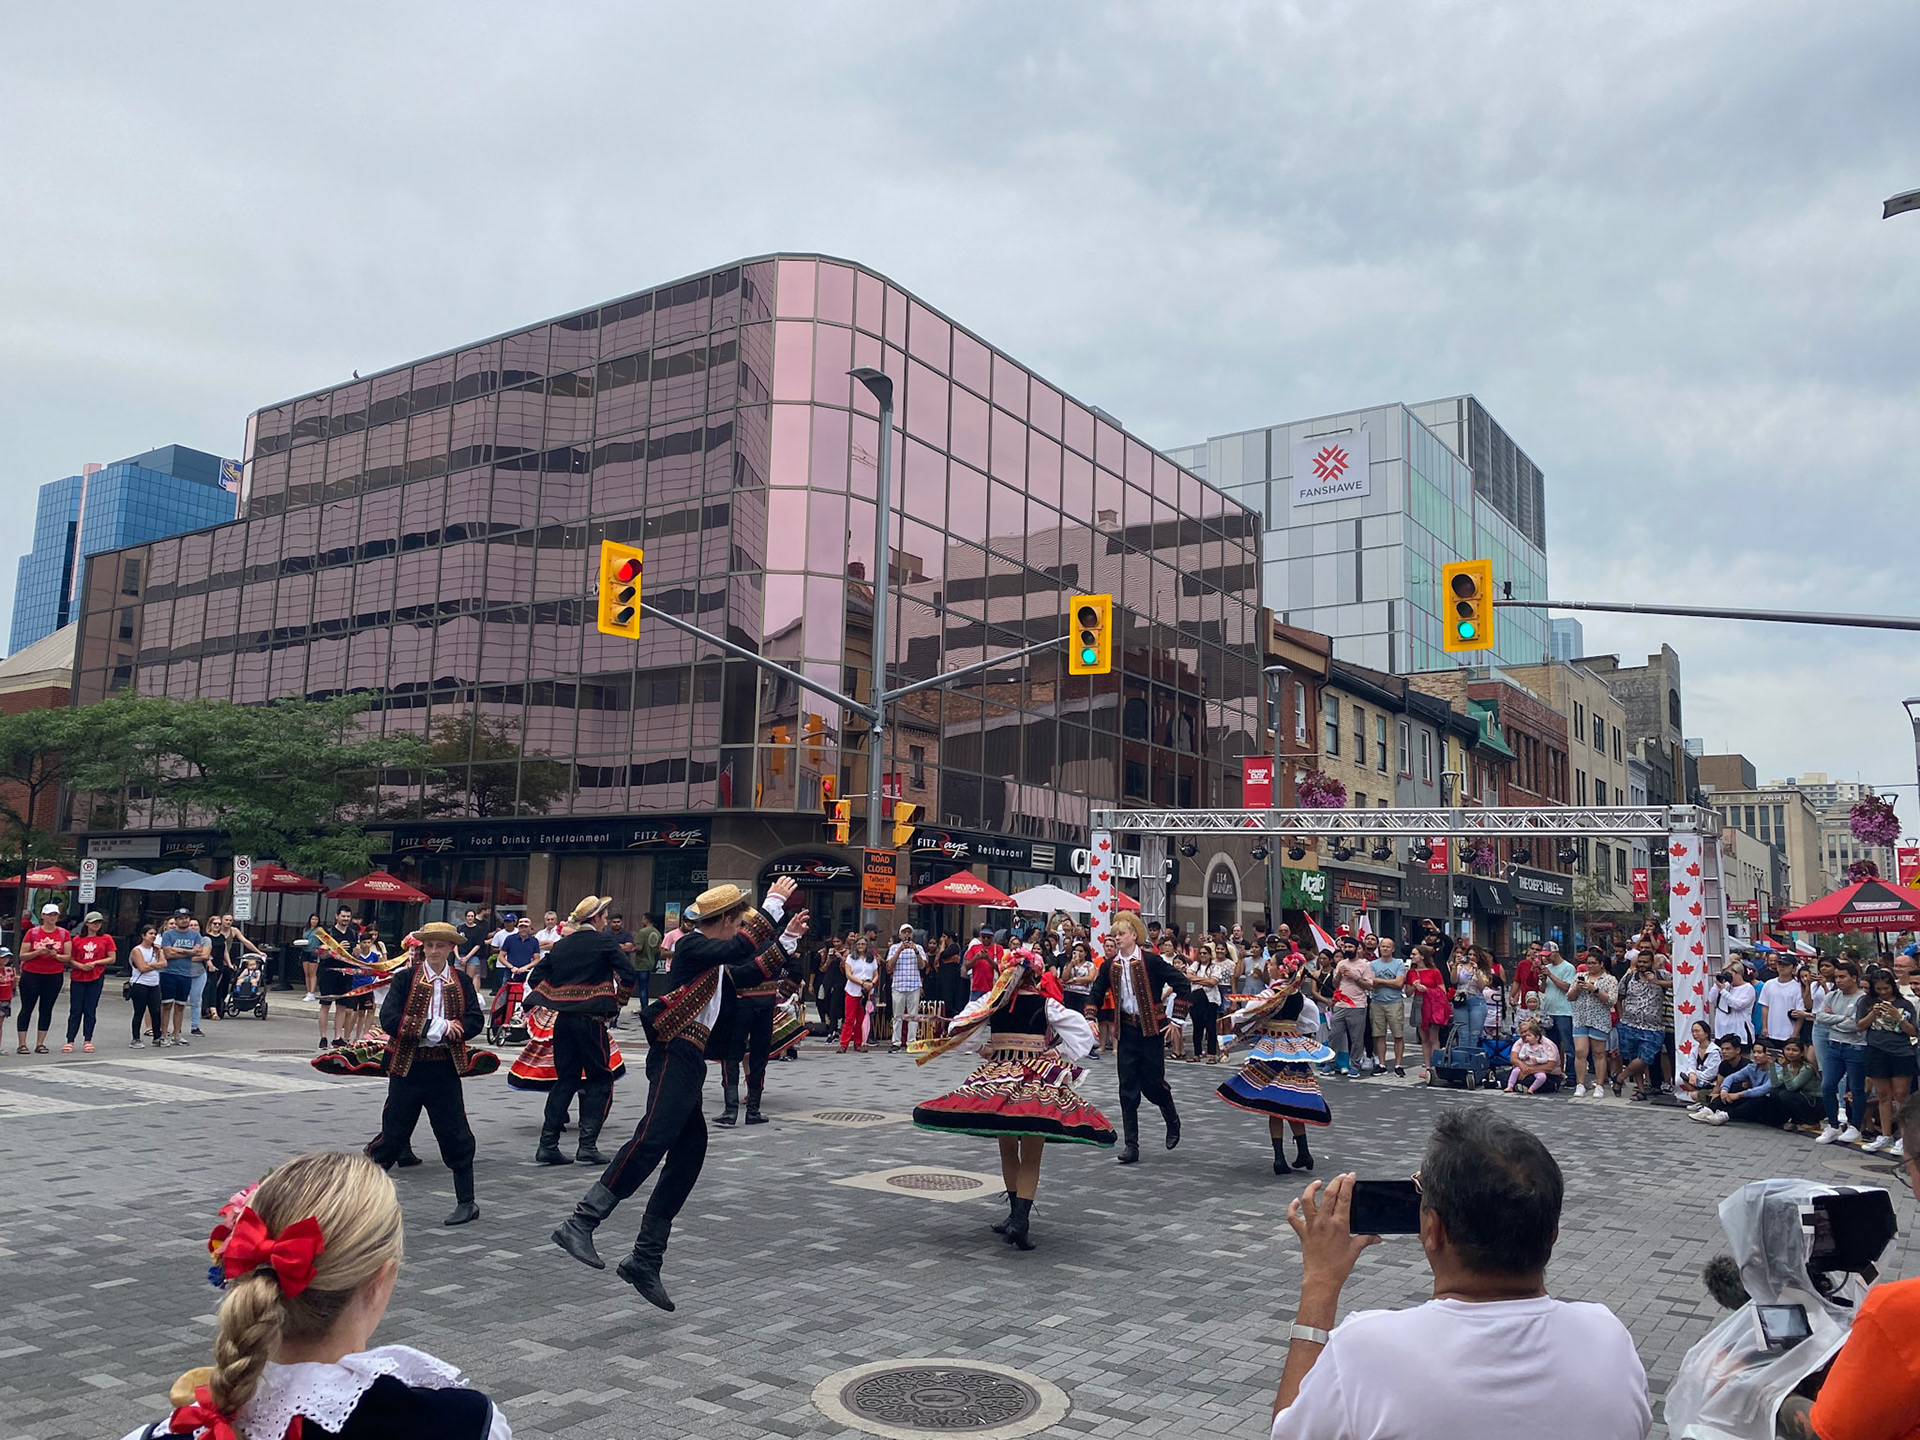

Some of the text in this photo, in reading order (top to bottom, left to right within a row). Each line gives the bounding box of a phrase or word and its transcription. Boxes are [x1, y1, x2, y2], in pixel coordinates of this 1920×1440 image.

[1300, 480, 1362, 498] FANSHAWE
[471, 833, 610, 845] Food Drinks Entertainment
[634, 831, 658, 840] FITZ
[400, 838, 419, 846] FITZ
[917, 838, 936, 848] FITZ
[166, 843, 180, 851] FITZ
[977, 844, 1024, 858] Restaurant
[871, 855, 890, 864] ROAD
[774, 864, 801, 872] FITZ
[867, 865, 893, 874] CLOSED
[1216, 873, 1228, 884] 114
[1518, 876, 1529, 890] THE
[1528, 878, 1544, 892] CHEF'S
[1543, 881, 1557, 895] TABLE
[1897, 914, 1915, 922] HERE.
